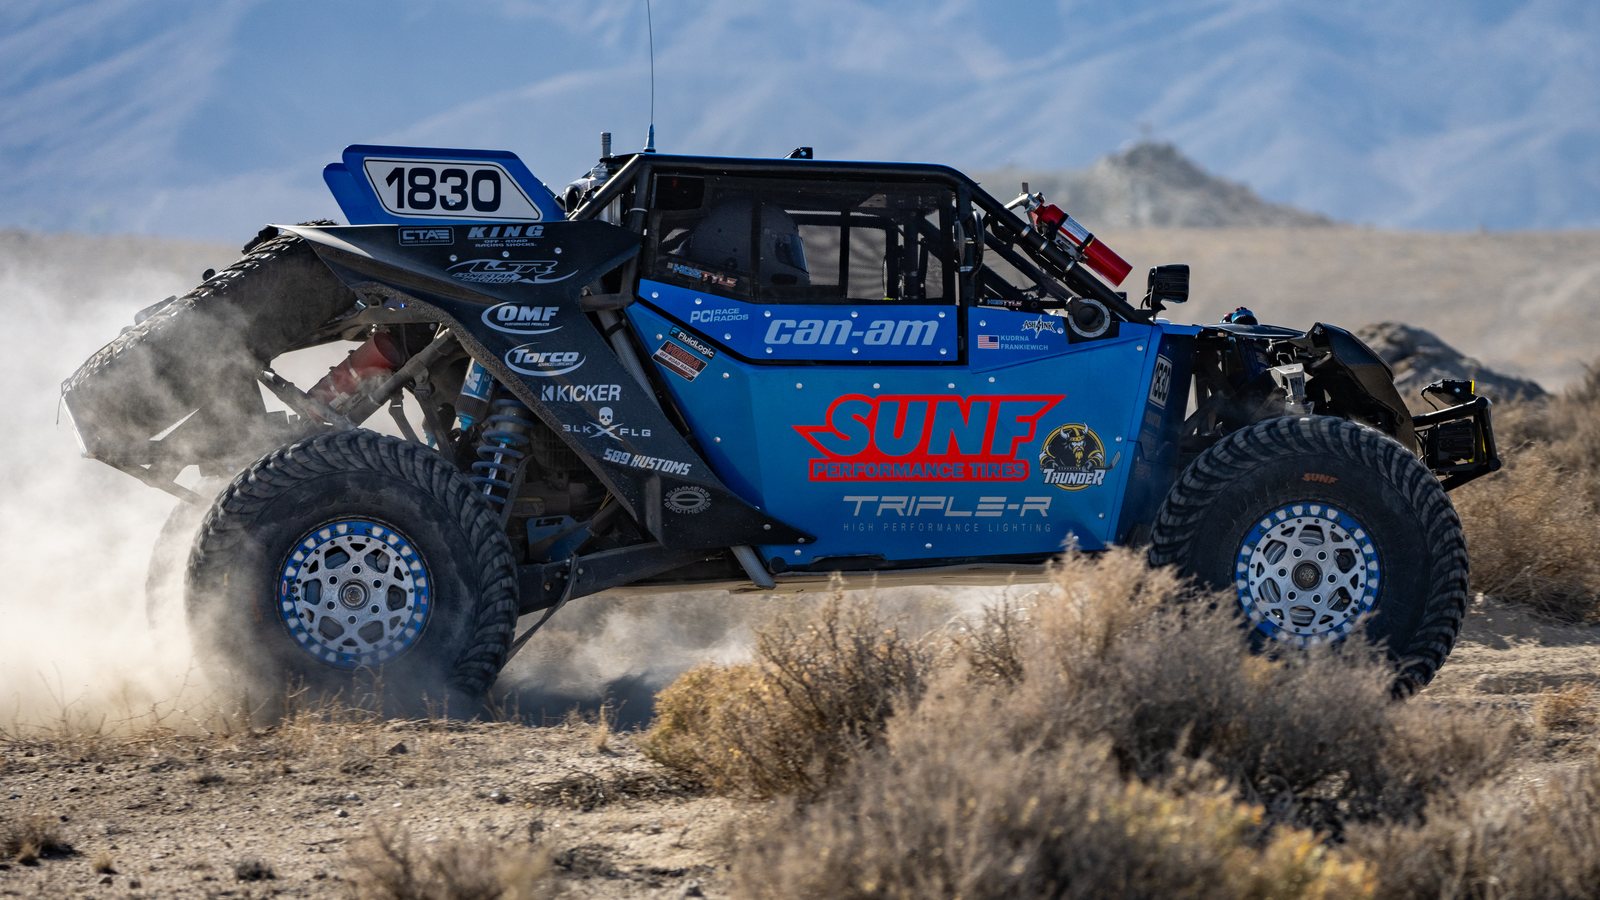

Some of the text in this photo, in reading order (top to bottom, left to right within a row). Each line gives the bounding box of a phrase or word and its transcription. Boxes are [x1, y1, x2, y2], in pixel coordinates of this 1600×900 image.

[385, 167, 501, 213] 1830
[467, 225, 545, 239] KING
[496, 305, 560, 322] OMF
[690, 309, 714, 324] PCI
[714, 307, 740, 315] RACE
[714, 313, 749, 323] RADIOS
[763, 319, 939, 346] can-am
[1000, 343, 1049, 351] FRANKIEWICH
[556, 384, 622, 402] KICKER
[619, 427, 652, 437] FLG
[791, 394, 1066, 460] SUNF
[602, 448, 692, 476] 589 KUSTOMS
[812, 462, 1026, 479] PERFORMANCE TIRES
[1043, 468, 1106, 486] THUNDER
[1301, 472, 1339, 485] SUNF
[843, 495, 1053, 517] TRIPLE-R
[843, 523, 1052, 533] HIGH PERFORMANCE LIGHTING
